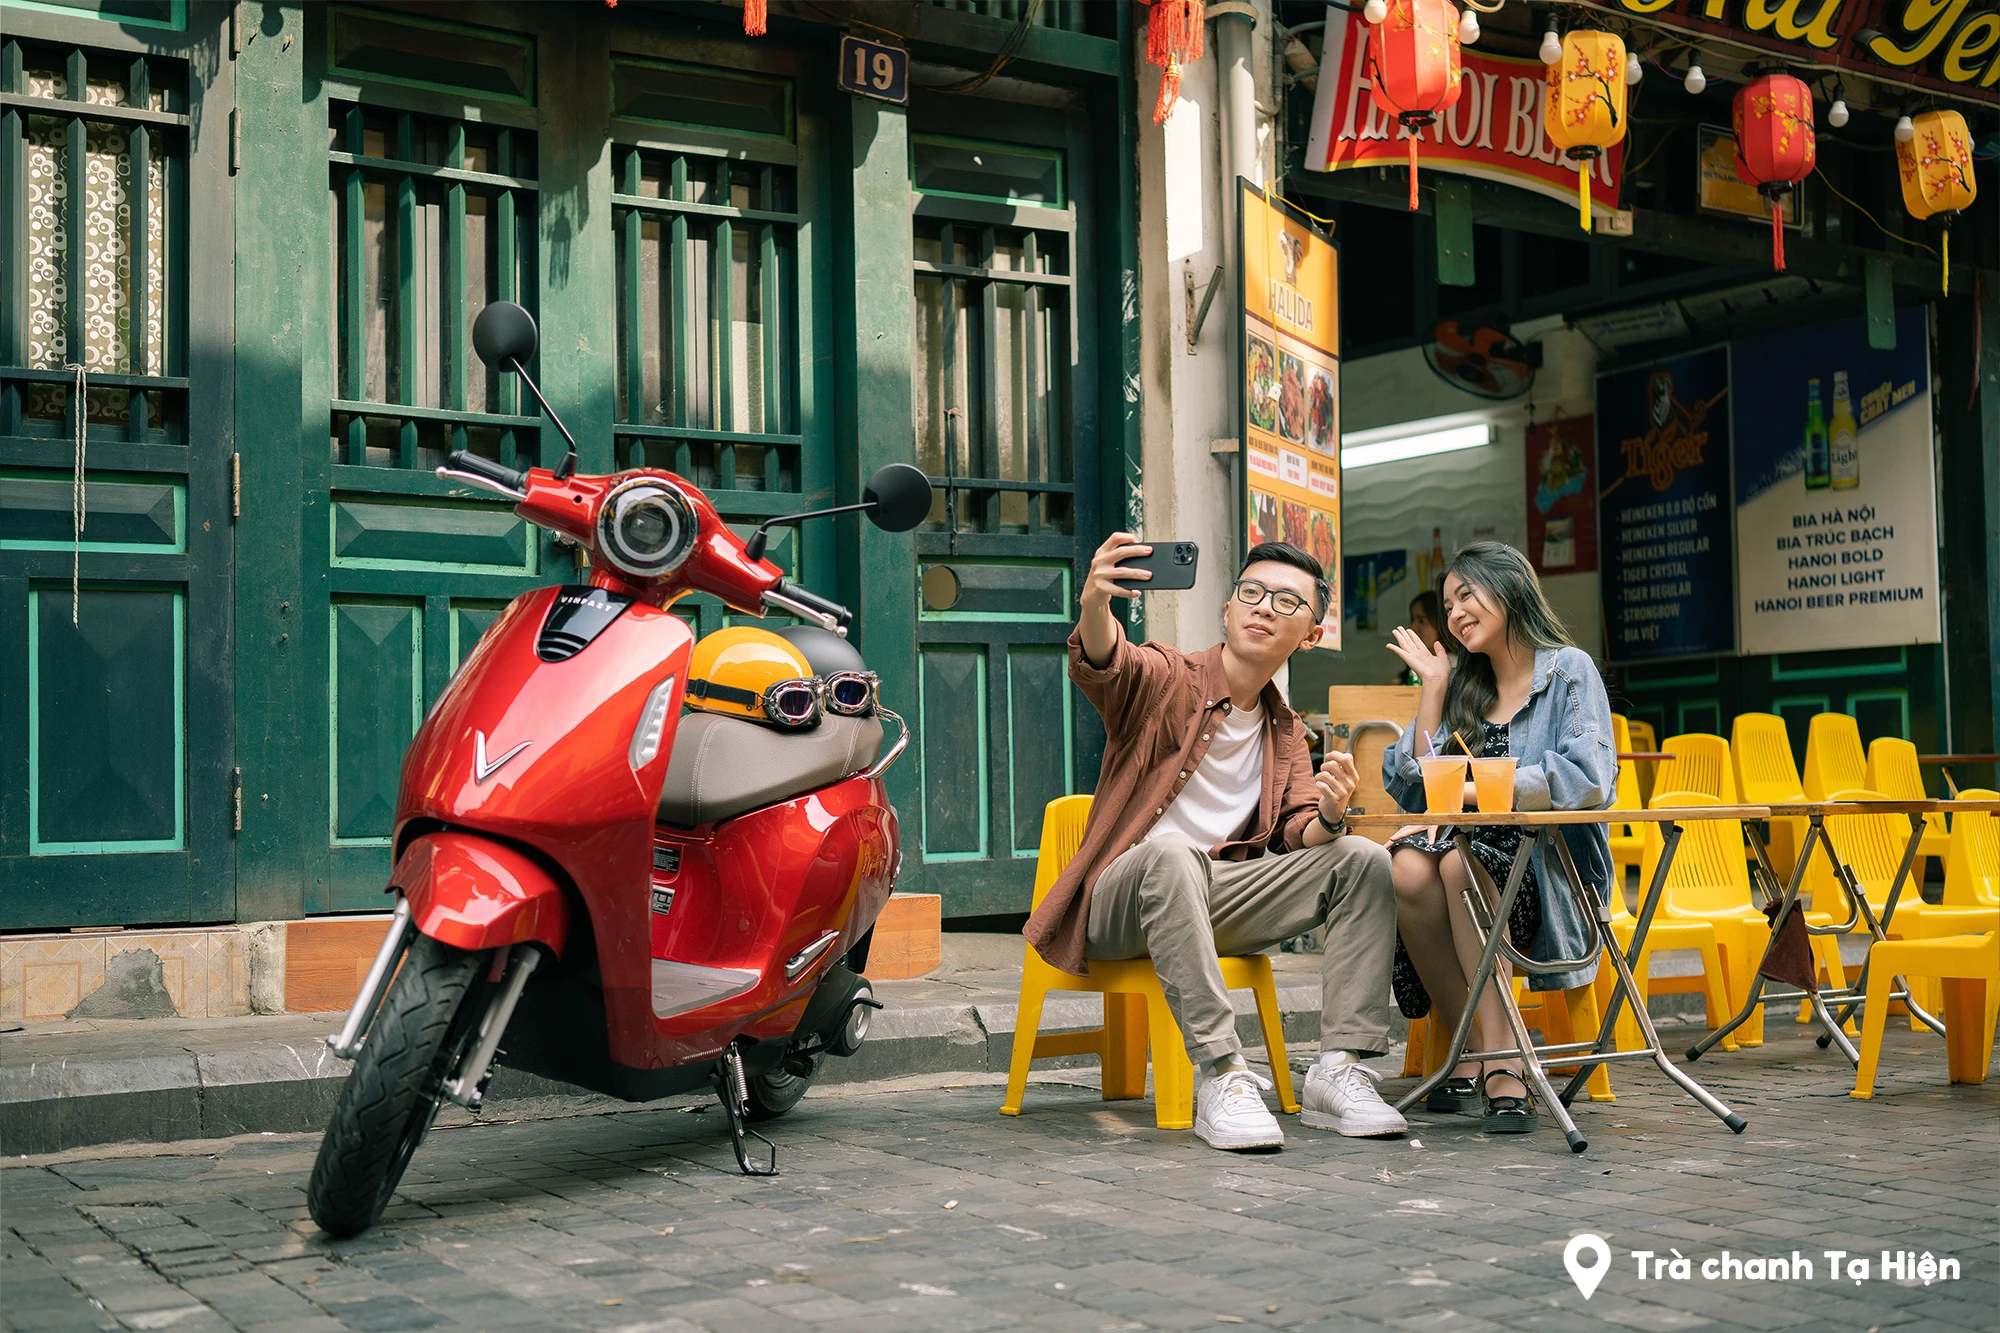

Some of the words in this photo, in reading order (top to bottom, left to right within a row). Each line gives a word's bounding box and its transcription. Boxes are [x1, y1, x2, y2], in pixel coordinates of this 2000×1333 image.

[1867, 0, 2000, 88] Ye
[854, 47, 894, 91] 19
[1267, 278, 1314, 333] HALIDA
[1620, 431, 1709, 491] Tiger
[1620, 502, 1665, 524] HEINEKEN
[1792, 513, 1818, 529] BIA
[1821, 506, 1844, 527] HÀ
[1847, 503, 1876, 524] NỘI
[1621, 522, 1665, 544] HEINEKEN
[1666, 517, 1698, 538] SILVER
[1776, 536, 1802, 551] BIA
[1804, 528, 1847, 547] TRÚC
[1850, 525, 1894, 545] BẠCH
[1621, 543, 1666, 564] HEINEKEN
[1667, 536, 1710, 558] REGULAR
[1788, 553, 1837, 570] HANOI
[1841, 548, 1884, 565] BOLD
[1622, 565, 1648, 584] TIGER
[1649, 560, 1689, 581] CRYSTAL
[1787, 573, 1837, 591] HANOI
[1840, 568, 1886, 586] LIGHT
[560, 596, 613, 612] VINFAST
[1623, 585, 1649, 604] TIGER
[1649, 580, 1692, 600] REGULAR
[1755, 596, 1802, 614] HANOI
[1806, 593, 1845, 609] BEER
[1849, 587, 1924, 606] PREMIUM
[1623, 602, 1681, 623] STRONGBOW
[1623, 626, 1640, 644] BIA
